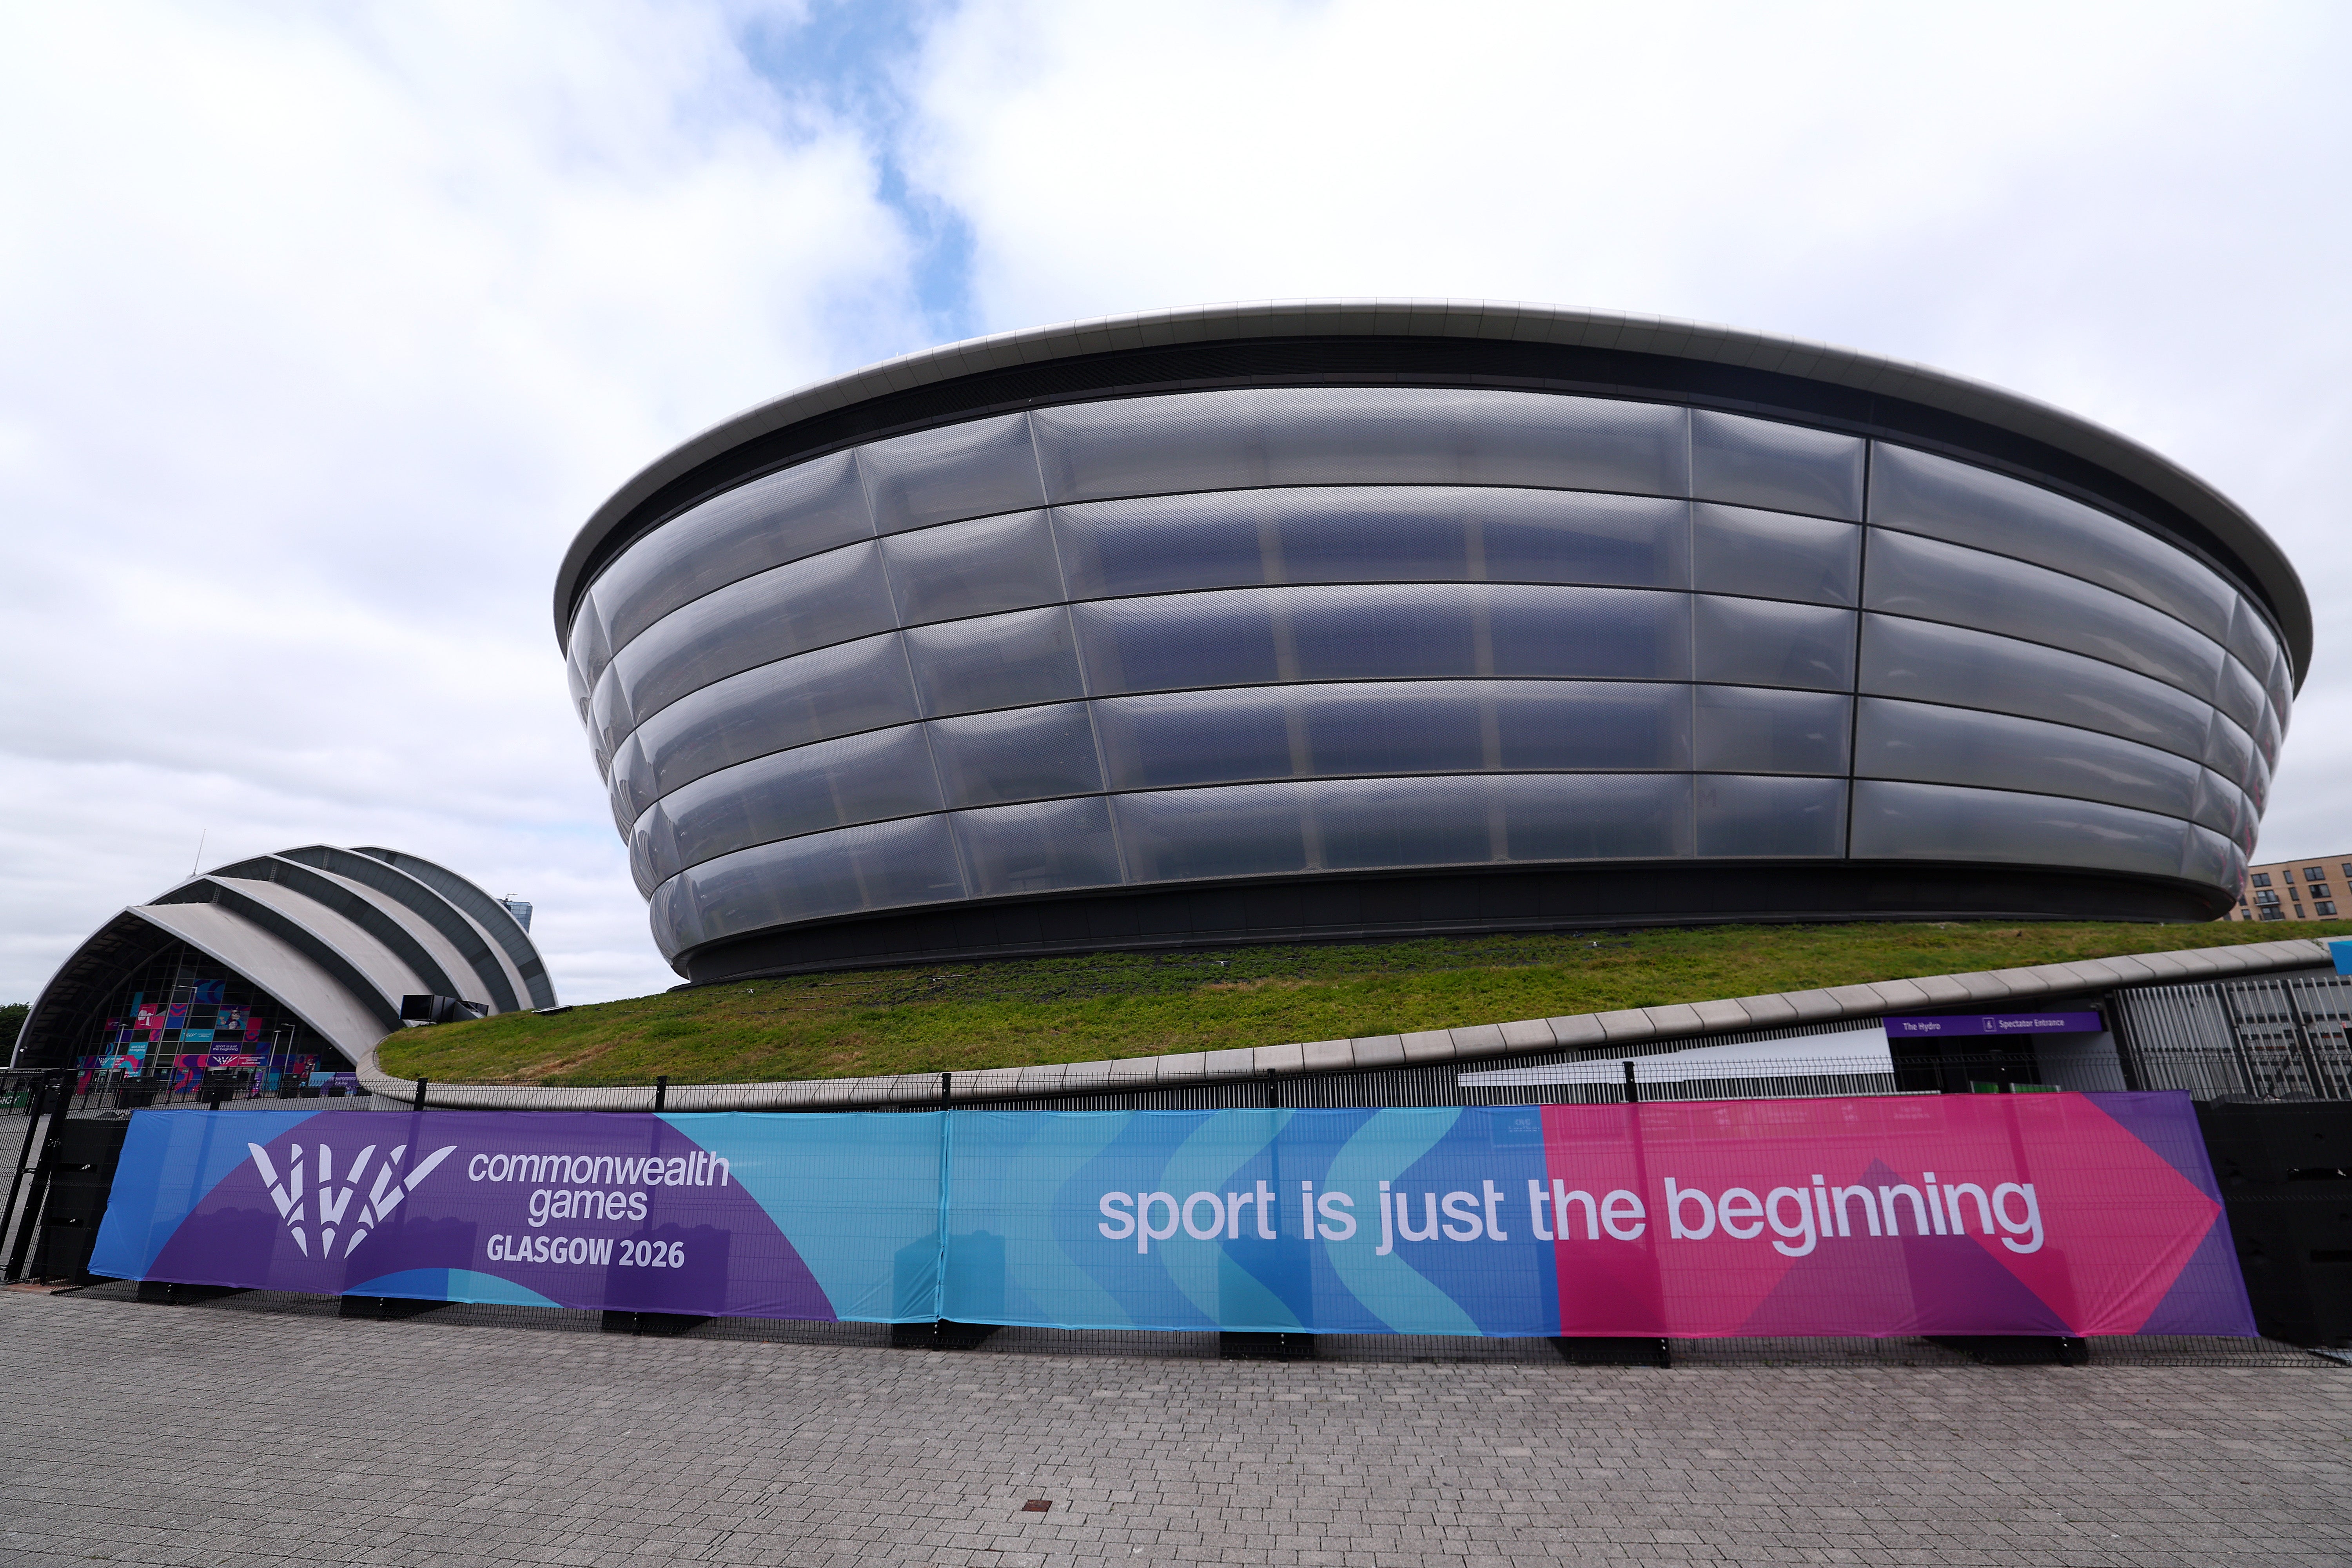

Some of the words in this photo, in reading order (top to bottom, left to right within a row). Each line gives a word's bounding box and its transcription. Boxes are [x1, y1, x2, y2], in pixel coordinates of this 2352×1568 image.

[1903, 1022, 1917, 1031] The
[1918, 1022, 1941, 1033] Hydro
[1999, 1019, 2033, 1029] Spectator
[2034, 1018, 2065, 1027] Entrance
[469, 1151, 730, 1186] commonwealth
[528, 1189, 647, 1227] games
[1098, 1180, 1276, 1254] sport
[1302, 1181, 1357, 1240] is
[1376, 1180, 1507, 1256] just
[1528, 1179, 1645, 1240] the
[1664, 1172, 2044, 1256] beginning
[487, 1234, 613, 1265] GLASGOW
[619, 1240, 684, 1268] 2026
